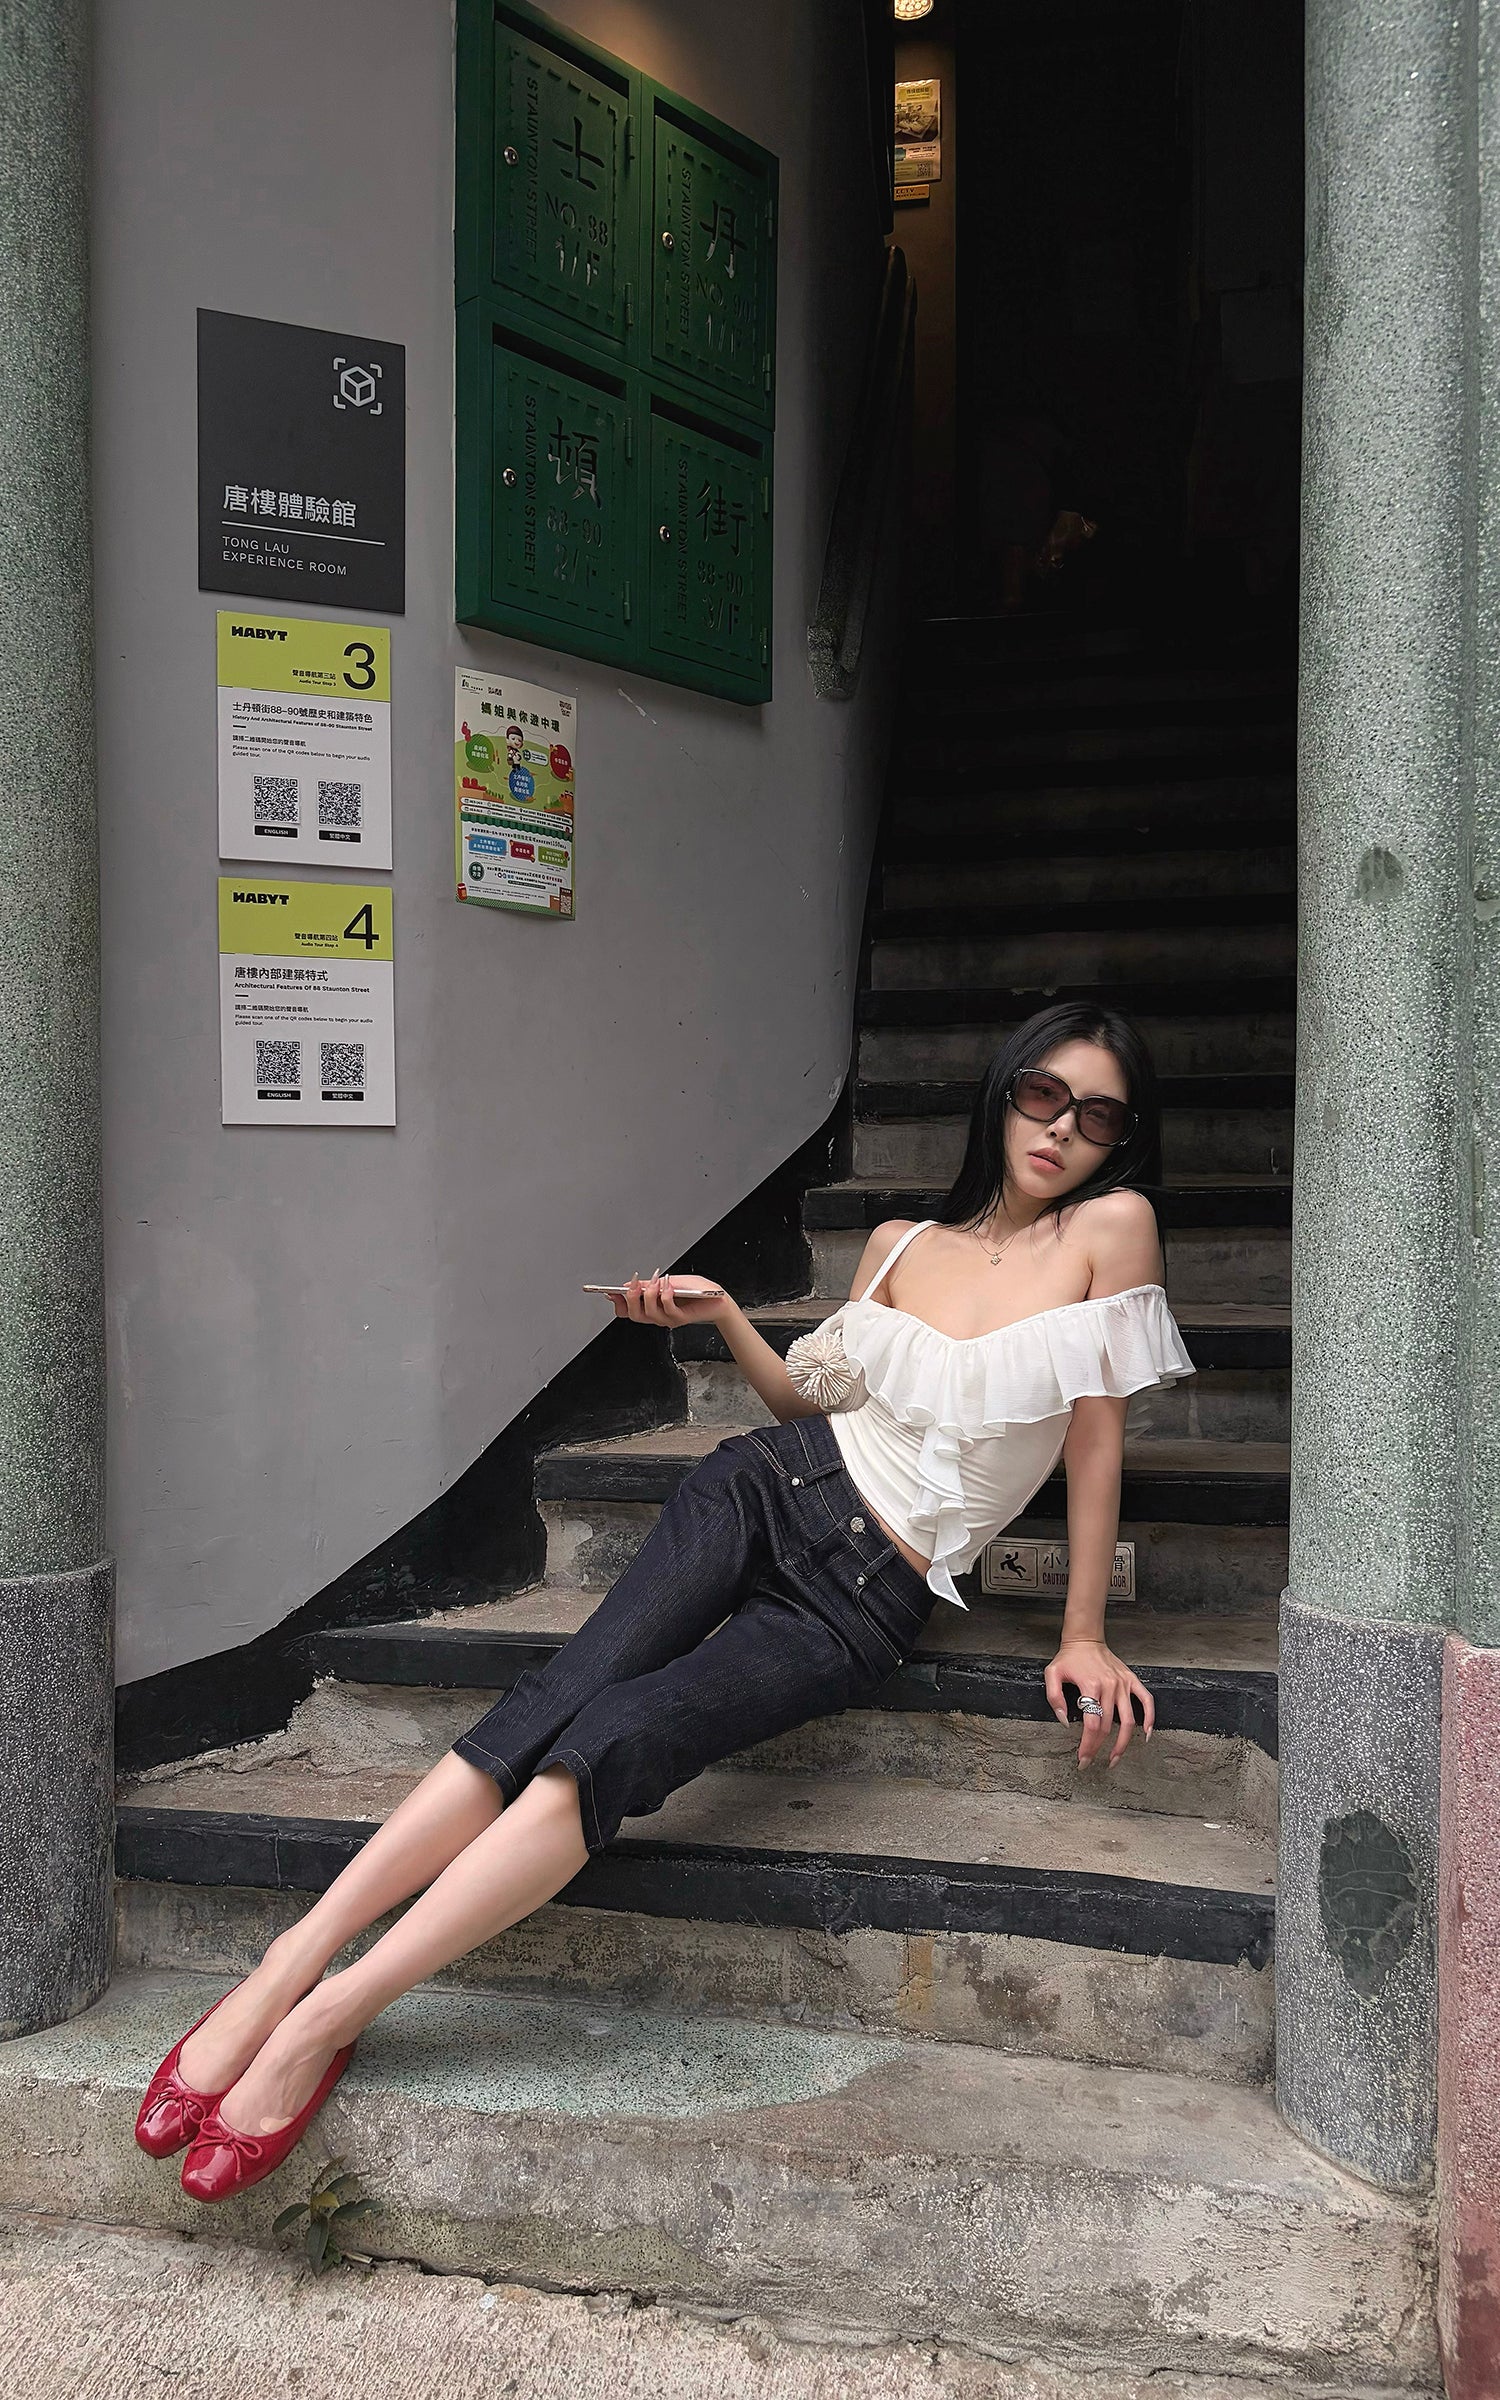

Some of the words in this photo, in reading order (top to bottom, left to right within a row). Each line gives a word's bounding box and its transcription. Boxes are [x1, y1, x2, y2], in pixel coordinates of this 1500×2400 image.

[526, 76, 538, 187] STAUNTON
[526, 188, 538, 264] STREET
[680, 167, 693, 269] STAUNTON
[698, 199, 748, 280] 丹
[679, 270, 692, 339] STREET
[524, 394, 538, 502] STAUNTON
[547, 415, 603, 511] 頓
[222, 484, 357, 528] 唐樓體驗館
[524, 503, 538, 576] STREET
[677, 457, 689, 556] STAUNTON
[695, 479, 748, 558] 街
[222, 535, 259, 551] TONG
[264, 541, 291, 555] LAU
[222, 550, 305, 571] EXPERIENCE
[309, 561, 348, 576] ROOM
[677, 557, 689, 624] STREET
[292, 669, 337, 680] 聲音導航第三站
[343, 642, 377, 691] 3
[232, 714, 250, 722] History
[293, 719, 314, 727] Features
[264, 828, 289, 836] ENGLISH
[343, 903, 380, 950] 4
[276, 983, 303, 991] Features
[266, 1091, 292, 1099] ENGLISH
